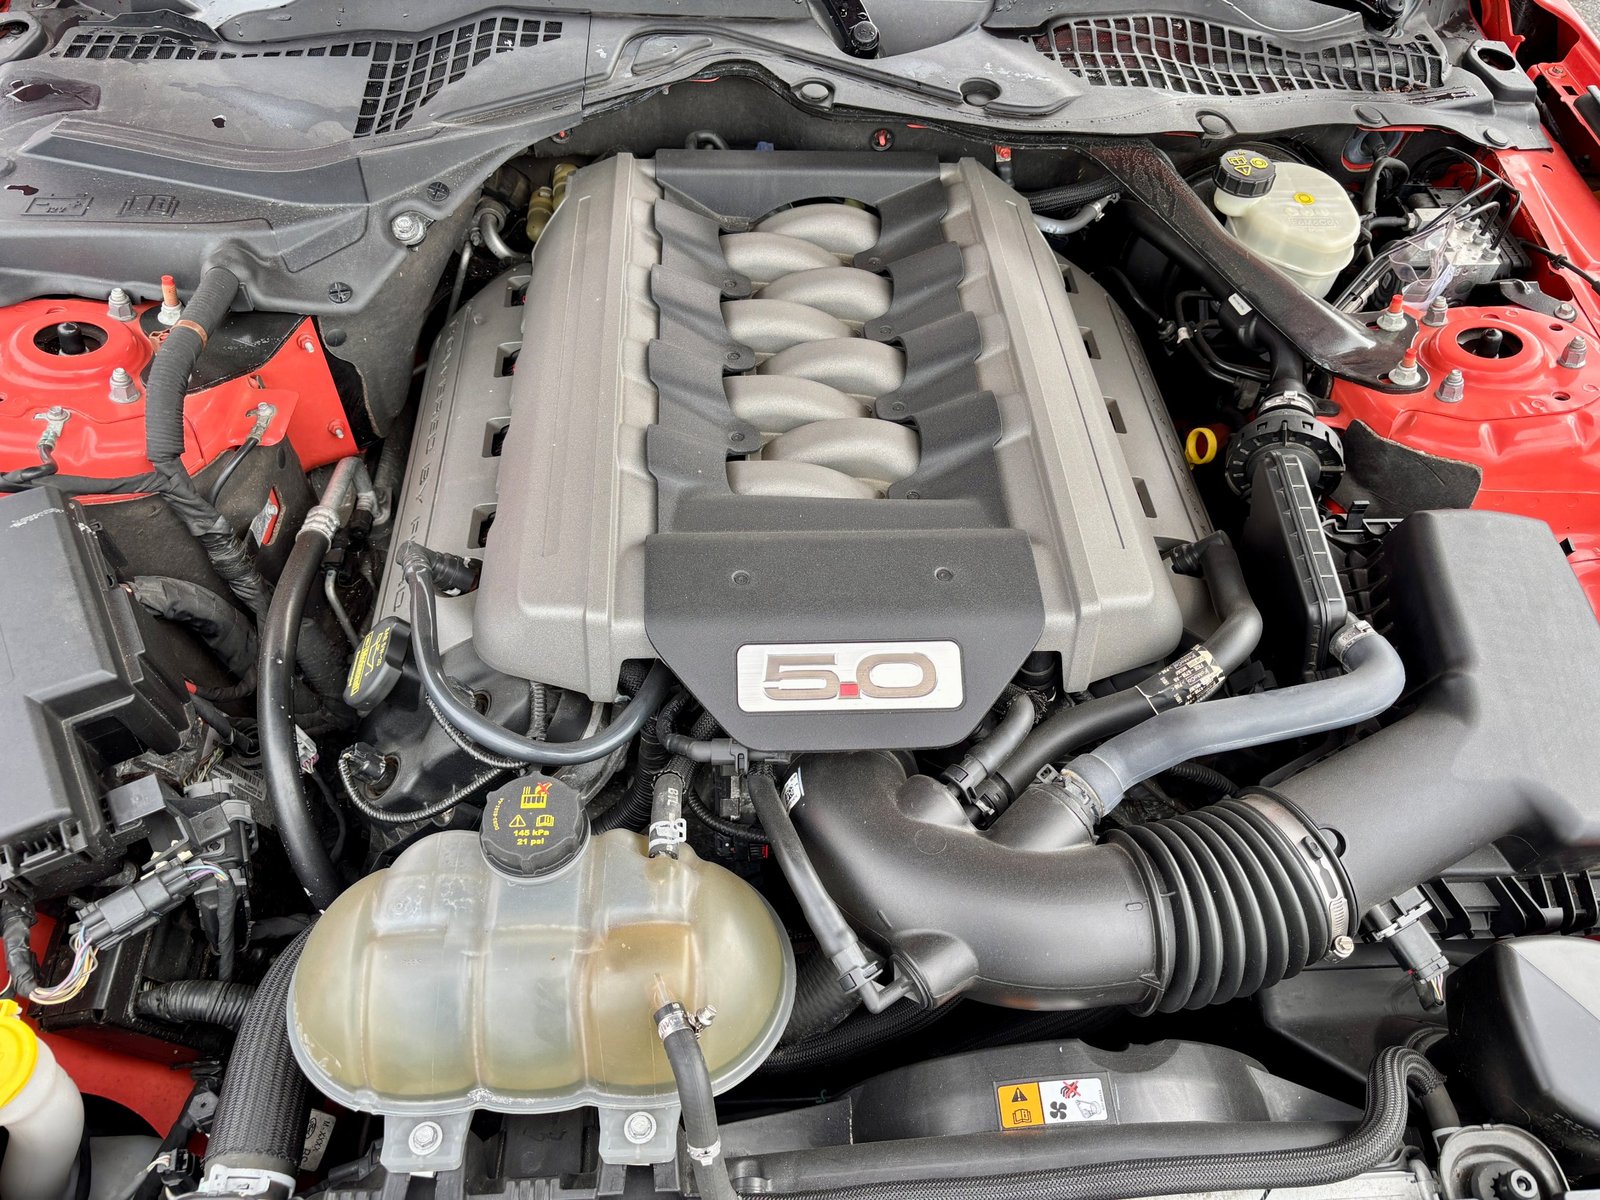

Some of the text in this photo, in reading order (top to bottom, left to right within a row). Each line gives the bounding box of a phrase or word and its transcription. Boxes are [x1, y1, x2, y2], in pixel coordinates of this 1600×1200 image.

[416, 463, 431, 503] BY
[763, 653, 938, 701] 5.0
[667, 787, 679, 806] BTL
[530, 838, 545, 846] psi
[532, 829, 550, 837] kPa
